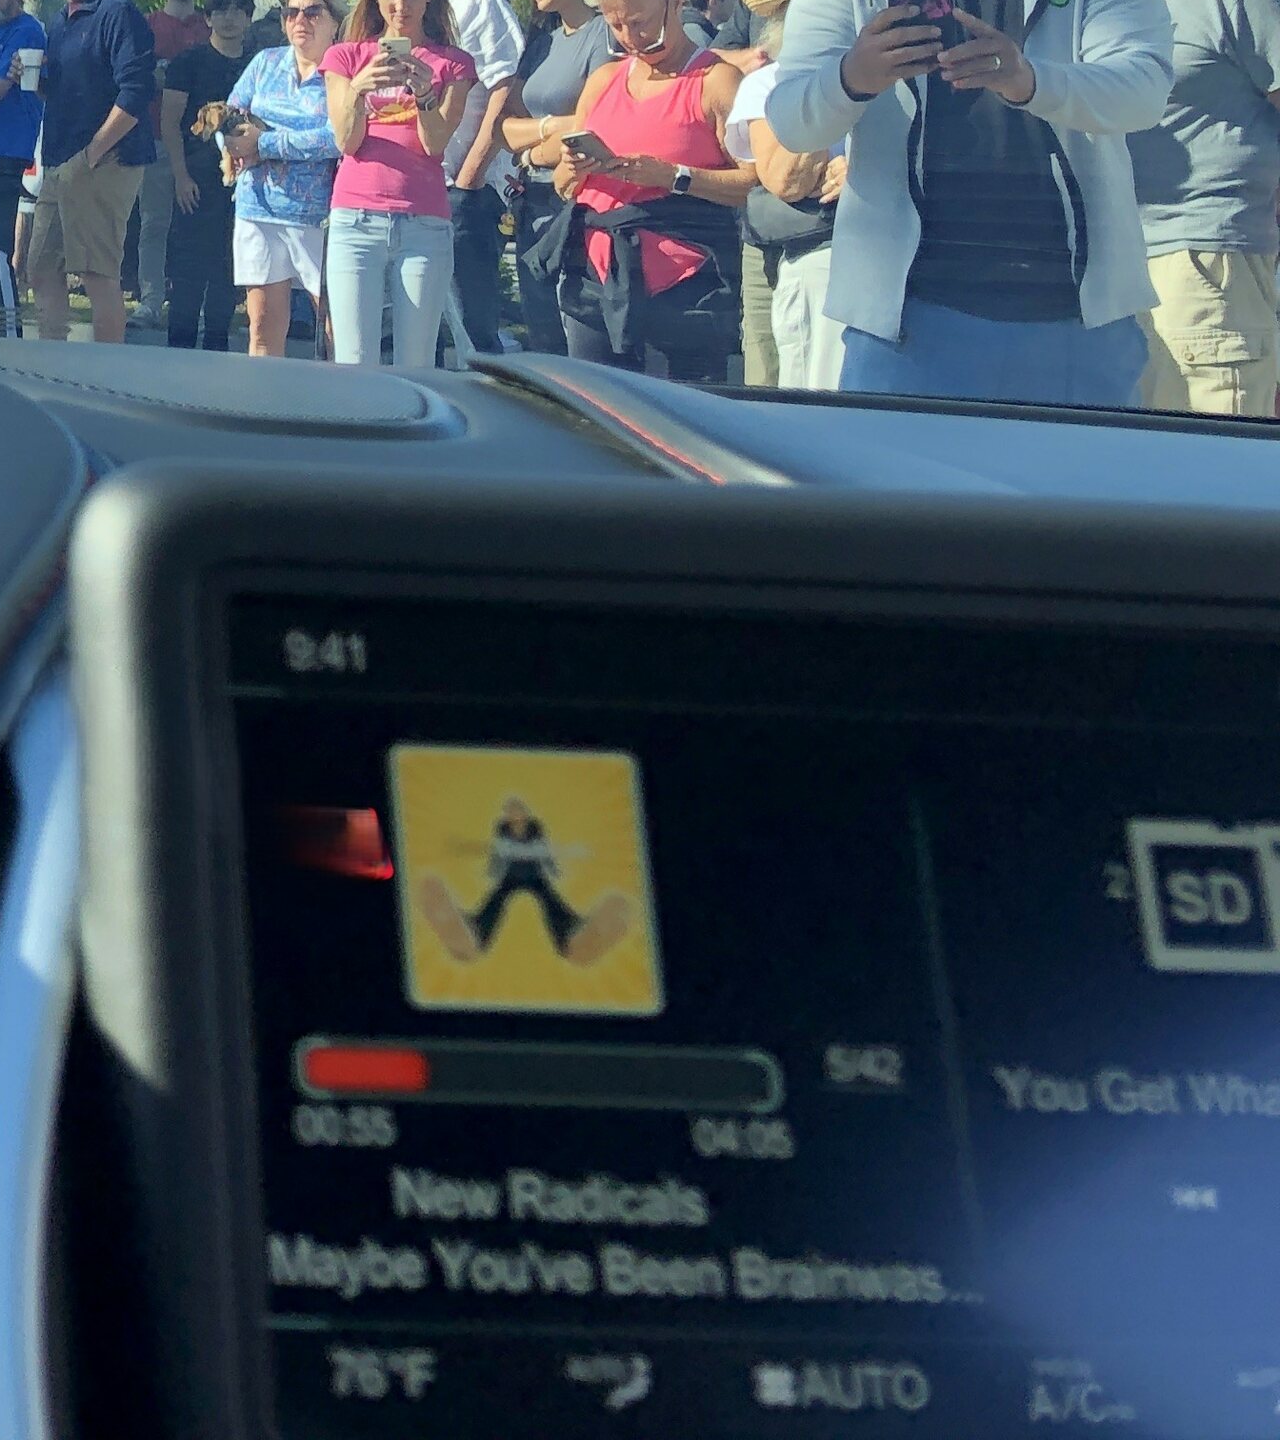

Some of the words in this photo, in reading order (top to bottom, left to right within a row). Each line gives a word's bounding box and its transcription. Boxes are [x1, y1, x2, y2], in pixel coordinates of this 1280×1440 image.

[1167, 870, 1251, 924] SD
[994, 1064, 1088, 1111] You
[1098, 1067, 1180, 1113] Get
[391, 1165, 499, 1221] New
[508, 1167, 710, 1226] Radicals
[268, 1232, 428, 1297] Maybe
[434, 1236, 593, 1295] You've
[599, 1242, 724, 1298] Been
[803, 1365, 929, 1410] AUTO
